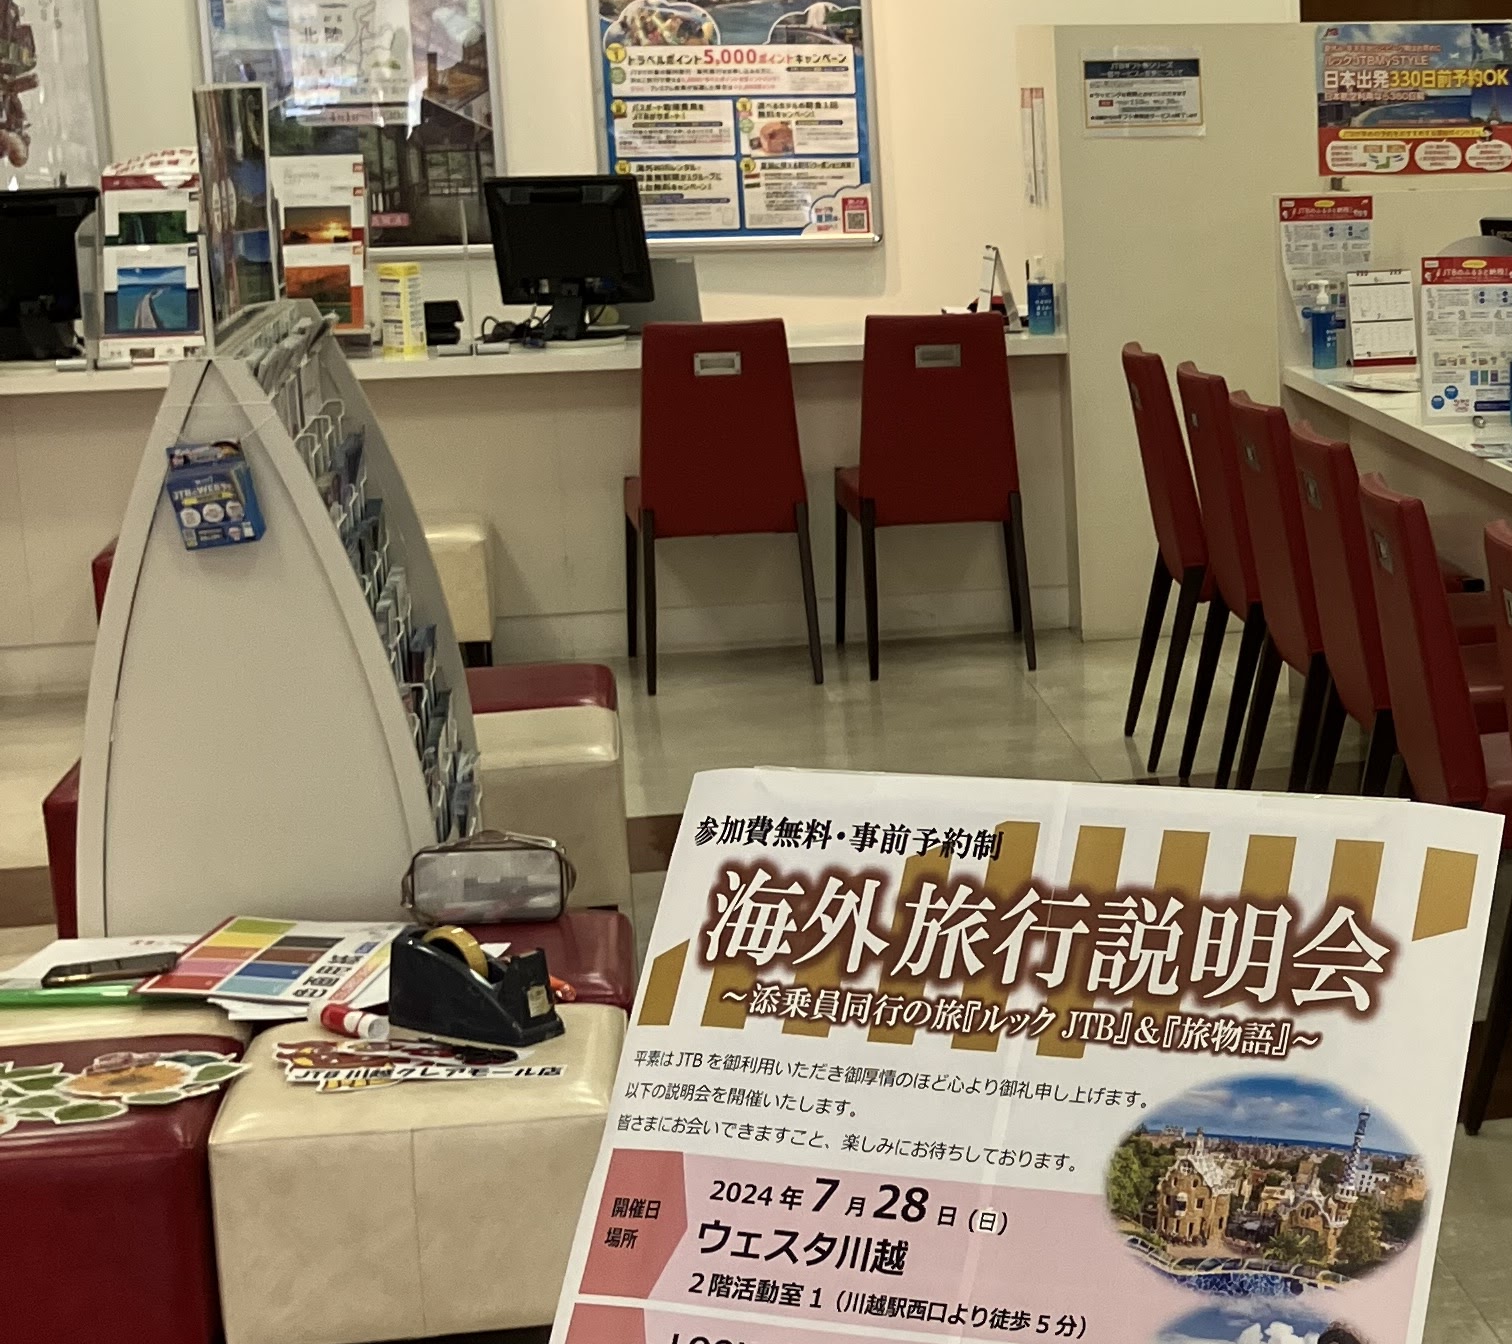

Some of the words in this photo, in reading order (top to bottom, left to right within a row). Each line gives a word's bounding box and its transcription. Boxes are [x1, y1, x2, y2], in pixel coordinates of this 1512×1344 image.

[1324, 69, 1509, 88] 日本出発330日前予約OK
[694, 814, 1006, 864] 参加費無料・事前予約制
[703, 866, 1393, 1013] 海外旅行説明会
[624, 1080, 859, 1119] 以下の説明会を開催いたします。
[617, 1113, 1077, 1174] 皆さまにお会いできますこと、楽しみにお待ちしております。
[611, 1197, 662, 1221] 開催日
[605, 1226, 638, 1249] 場所
